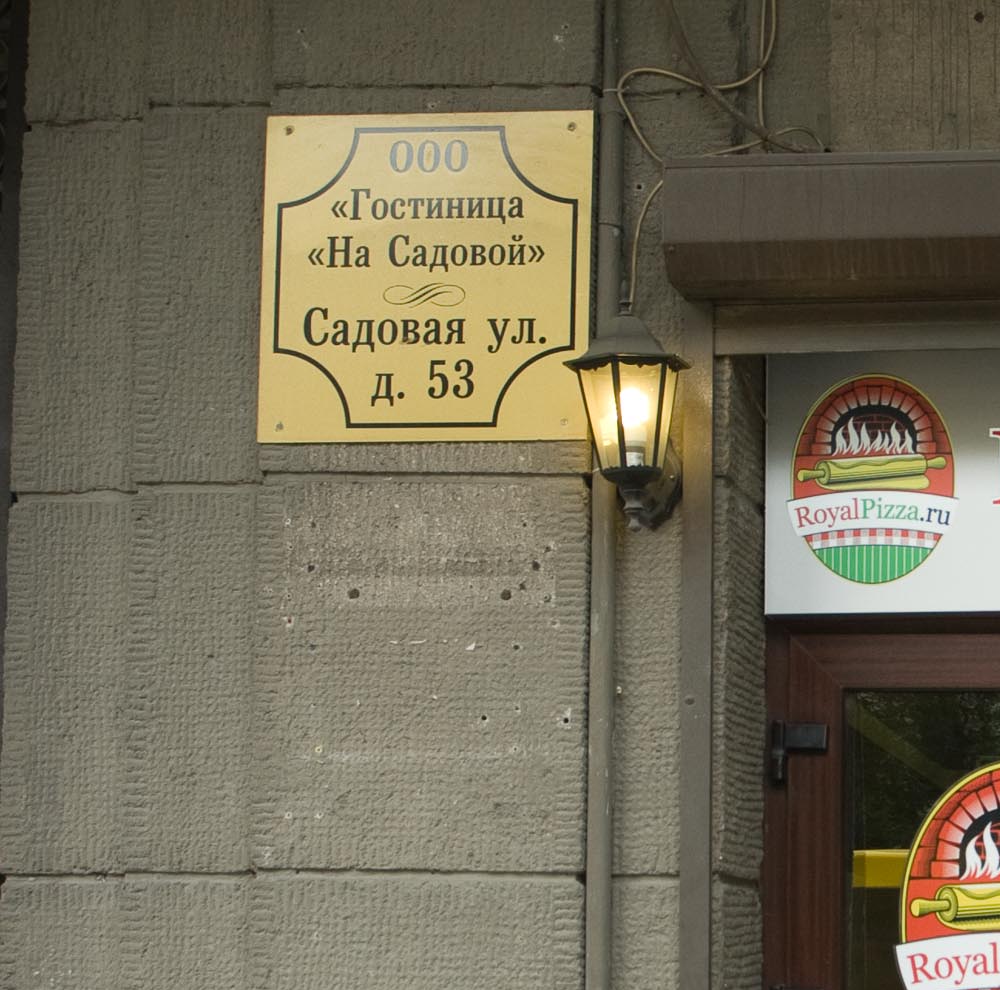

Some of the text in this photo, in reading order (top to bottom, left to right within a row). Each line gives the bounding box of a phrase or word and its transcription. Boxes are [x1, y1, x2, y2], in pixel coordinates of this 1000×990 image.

[389, 139, 469, 173] ООО
[331, 188, 525, 224] «Гостиница
[308, 234, 545, 273] «На Садовой»
[303, 307, 547, 353] Садовая ул.
[371, 359, 475, 407] д. 53
[794, 497, 951, 528] RoyalPizza.ru
